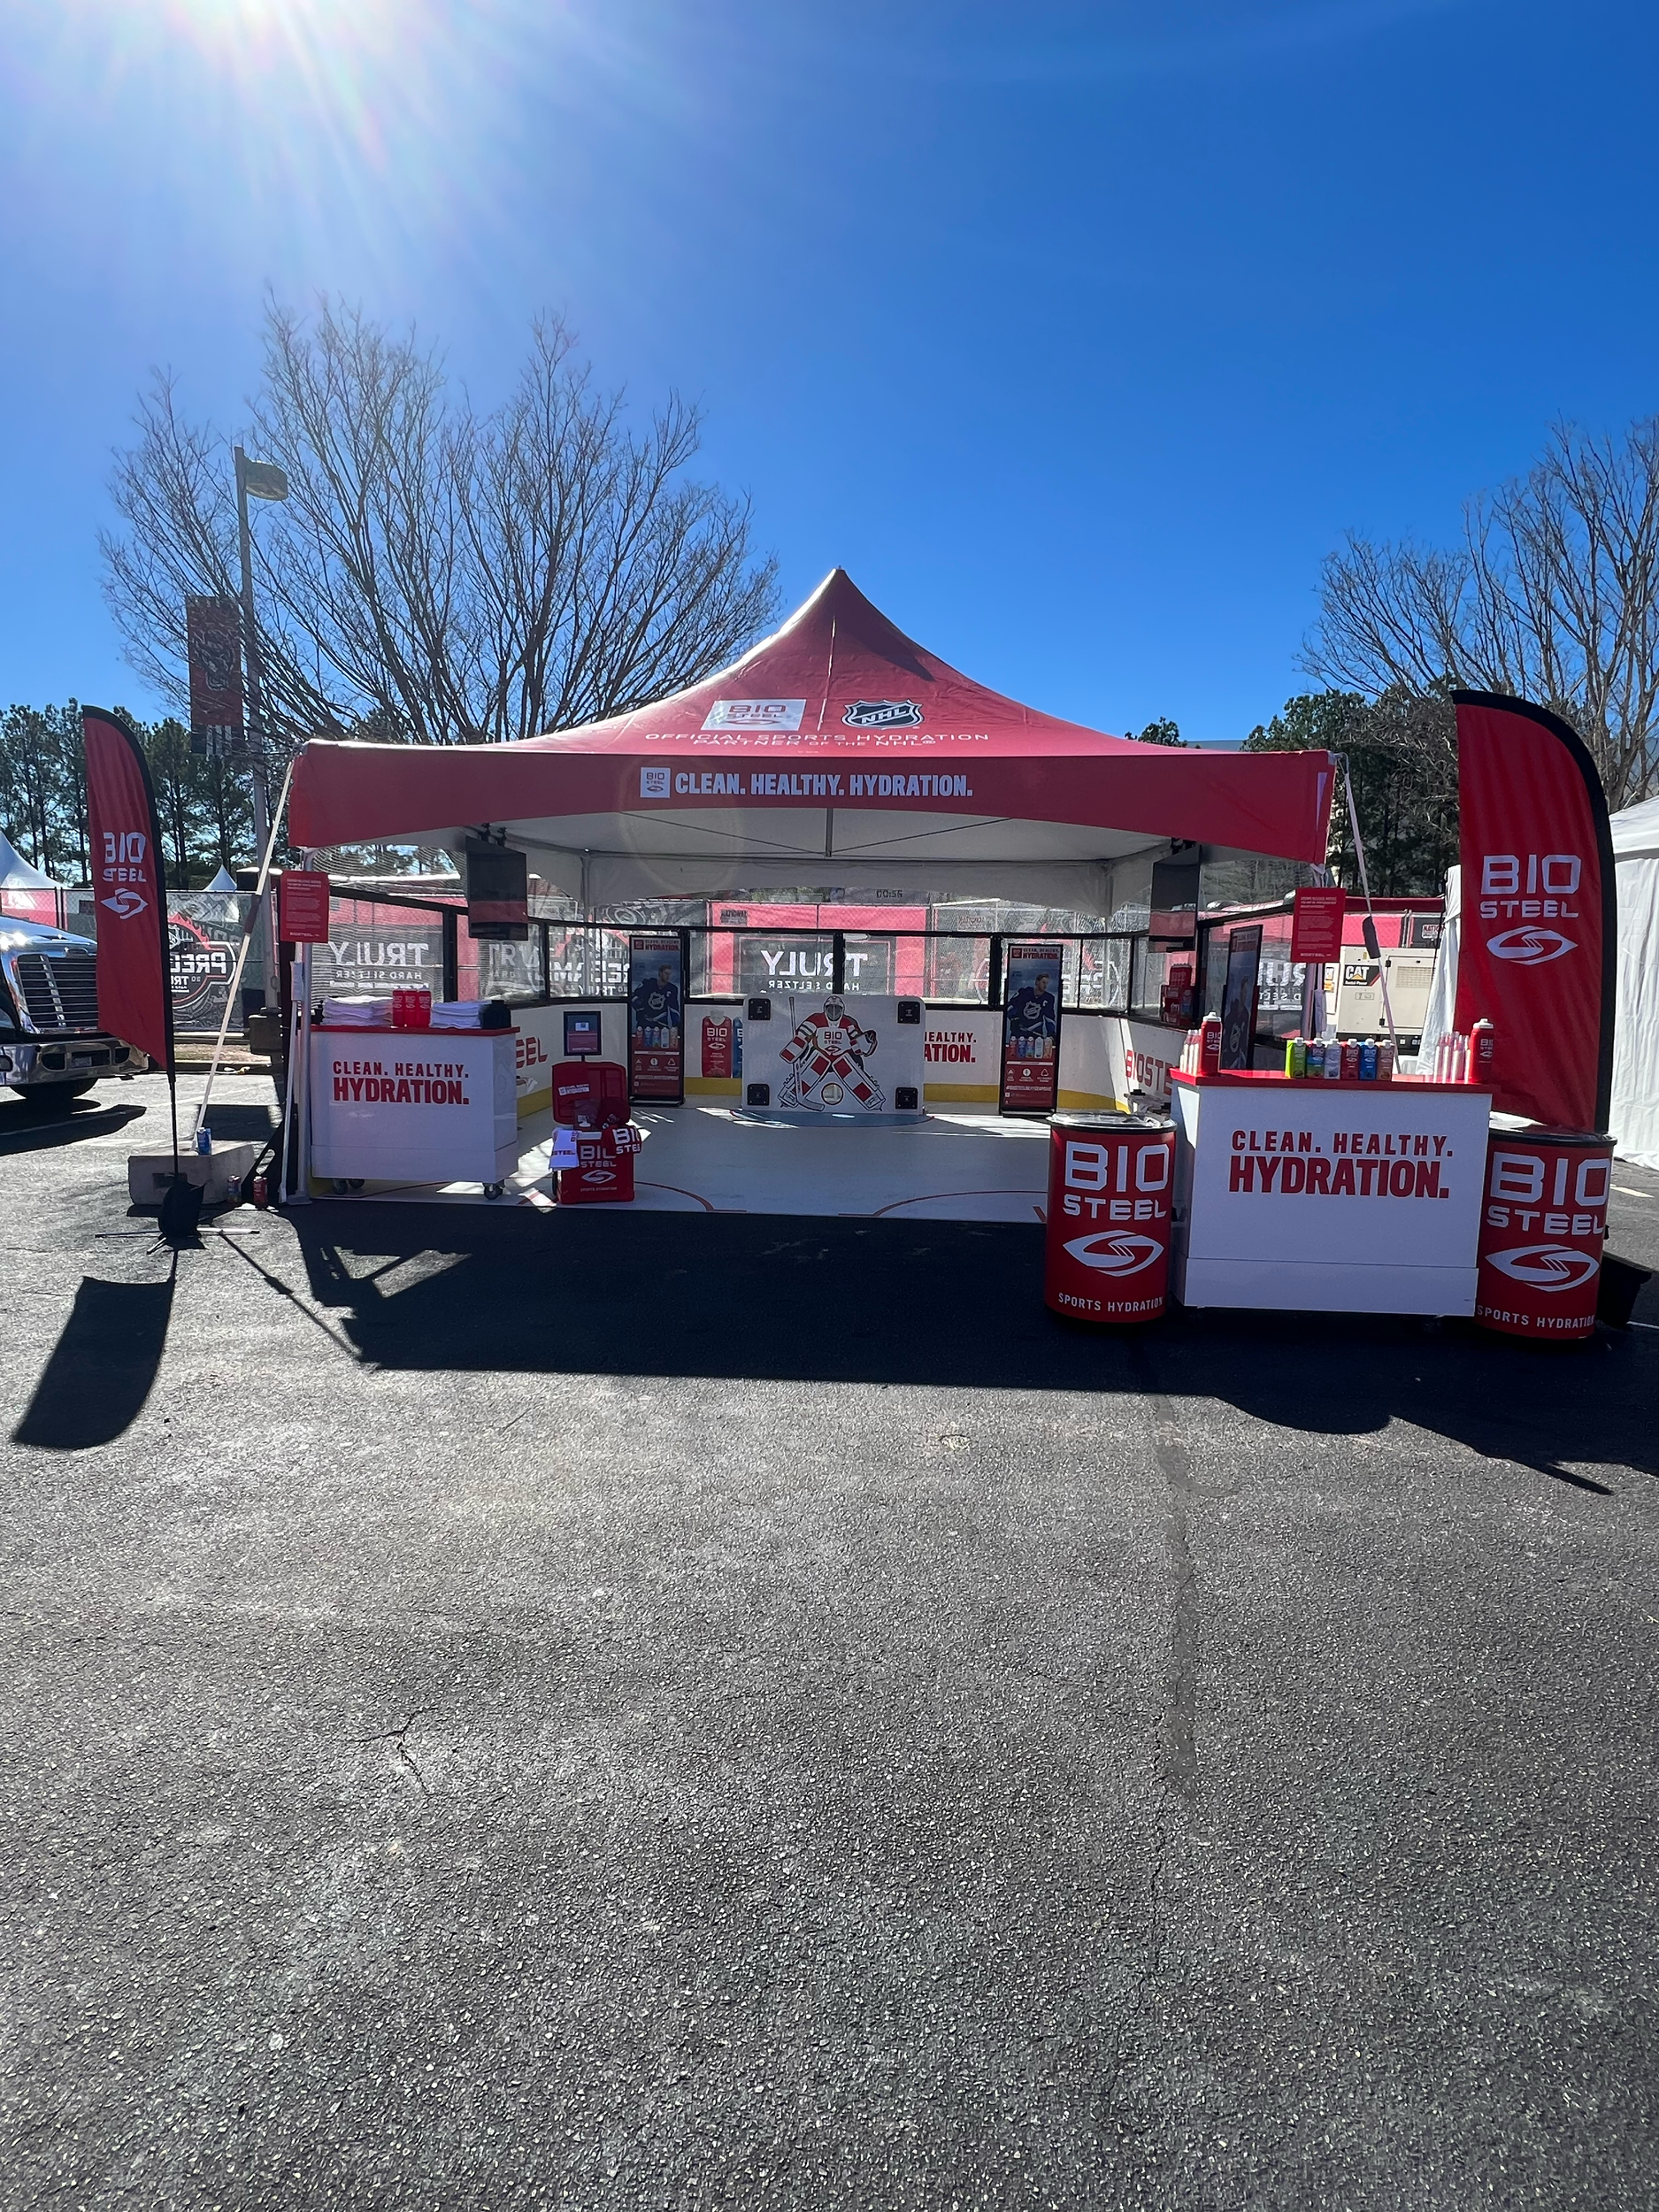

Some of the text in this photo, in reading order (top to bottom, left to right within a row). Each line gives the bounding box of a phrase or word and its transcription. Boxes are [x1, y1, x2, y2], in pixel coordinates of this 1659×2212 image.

[729, 704, 787, 713] BIO
[860, 707, 907, 725] NHL
[646, 772, 665, 780] BIO
[675, 772, 973, 796] CLEAN. HEALTHY. HYDRATION.
[1480, 854, 1582, 895] BIO
[1479, 900, 1579, 918] STEEL
[1346, 965, 1370, 980] CAT
[707, 1028, 728, 1037] BIO
[824, 1031, 842, 1040] BIO
[333, 1061, 469, 1078] CLEAN. HEALTHY.
[334, 1077, 469, 1104] HYDRATION.
[1232, 1130, 1454, 1157] CLEAN. HEALTHY.
[1064, 1141, 1170, 1192] BIO
[1229, 1155, 1450, 1199] HYDRATION.
[1490, 1151, 1611, 1207] BIO
[1063, 1194, 1168, 1221] STEEL
[1486, 1205, 1604, 1236] STEEL
[1058, 1293, 1164, 1313] SPORTS HYDRATION
[1477, 1304, 1530, 1325] SPORTS
